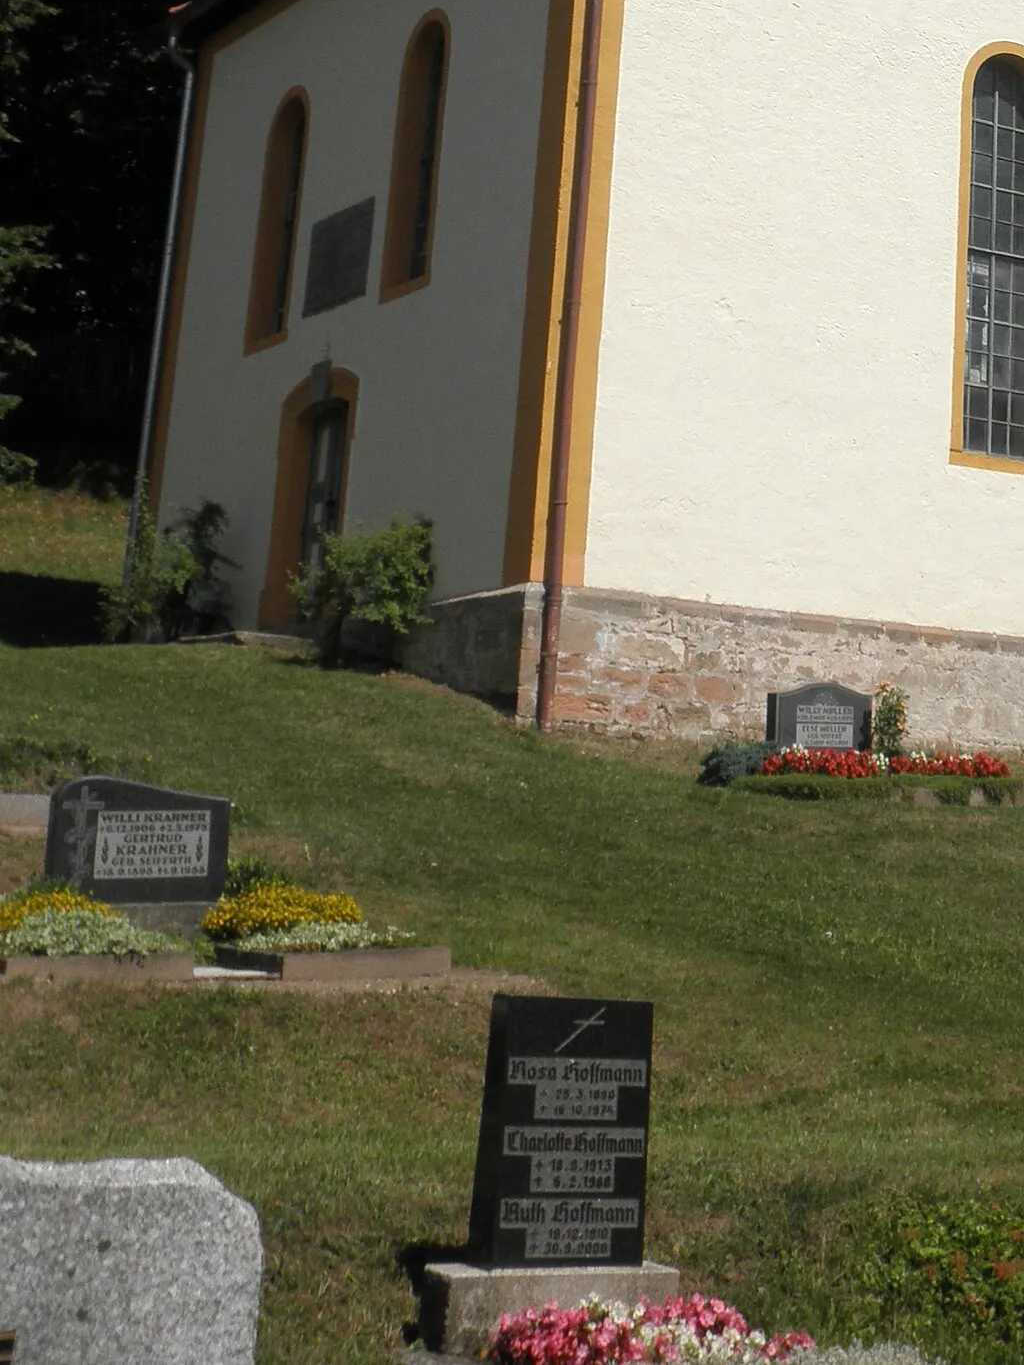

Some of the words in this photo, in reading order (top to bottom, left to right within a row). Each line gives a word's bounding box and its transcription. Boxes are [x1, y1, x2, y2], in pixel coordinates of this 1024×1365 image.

[100, 813, 140, 823] WILLI
[144, 812, 207, 823] KRAHNER
[124, 834, 183, 843] GERTRUD
[116, 844, 188, 855] KRAHNER
[509, 1059, 557, 1081] Rosa
[562, 1061, 643, 1084] Hoffmann
[507, 1130, 572, 1152] Charlotte
[574, 1131, 643, 1154] Hoffmann
[502, 1200, 546, 1225] Ruth
[551, 1201, 636, 1224] Hoffmann
